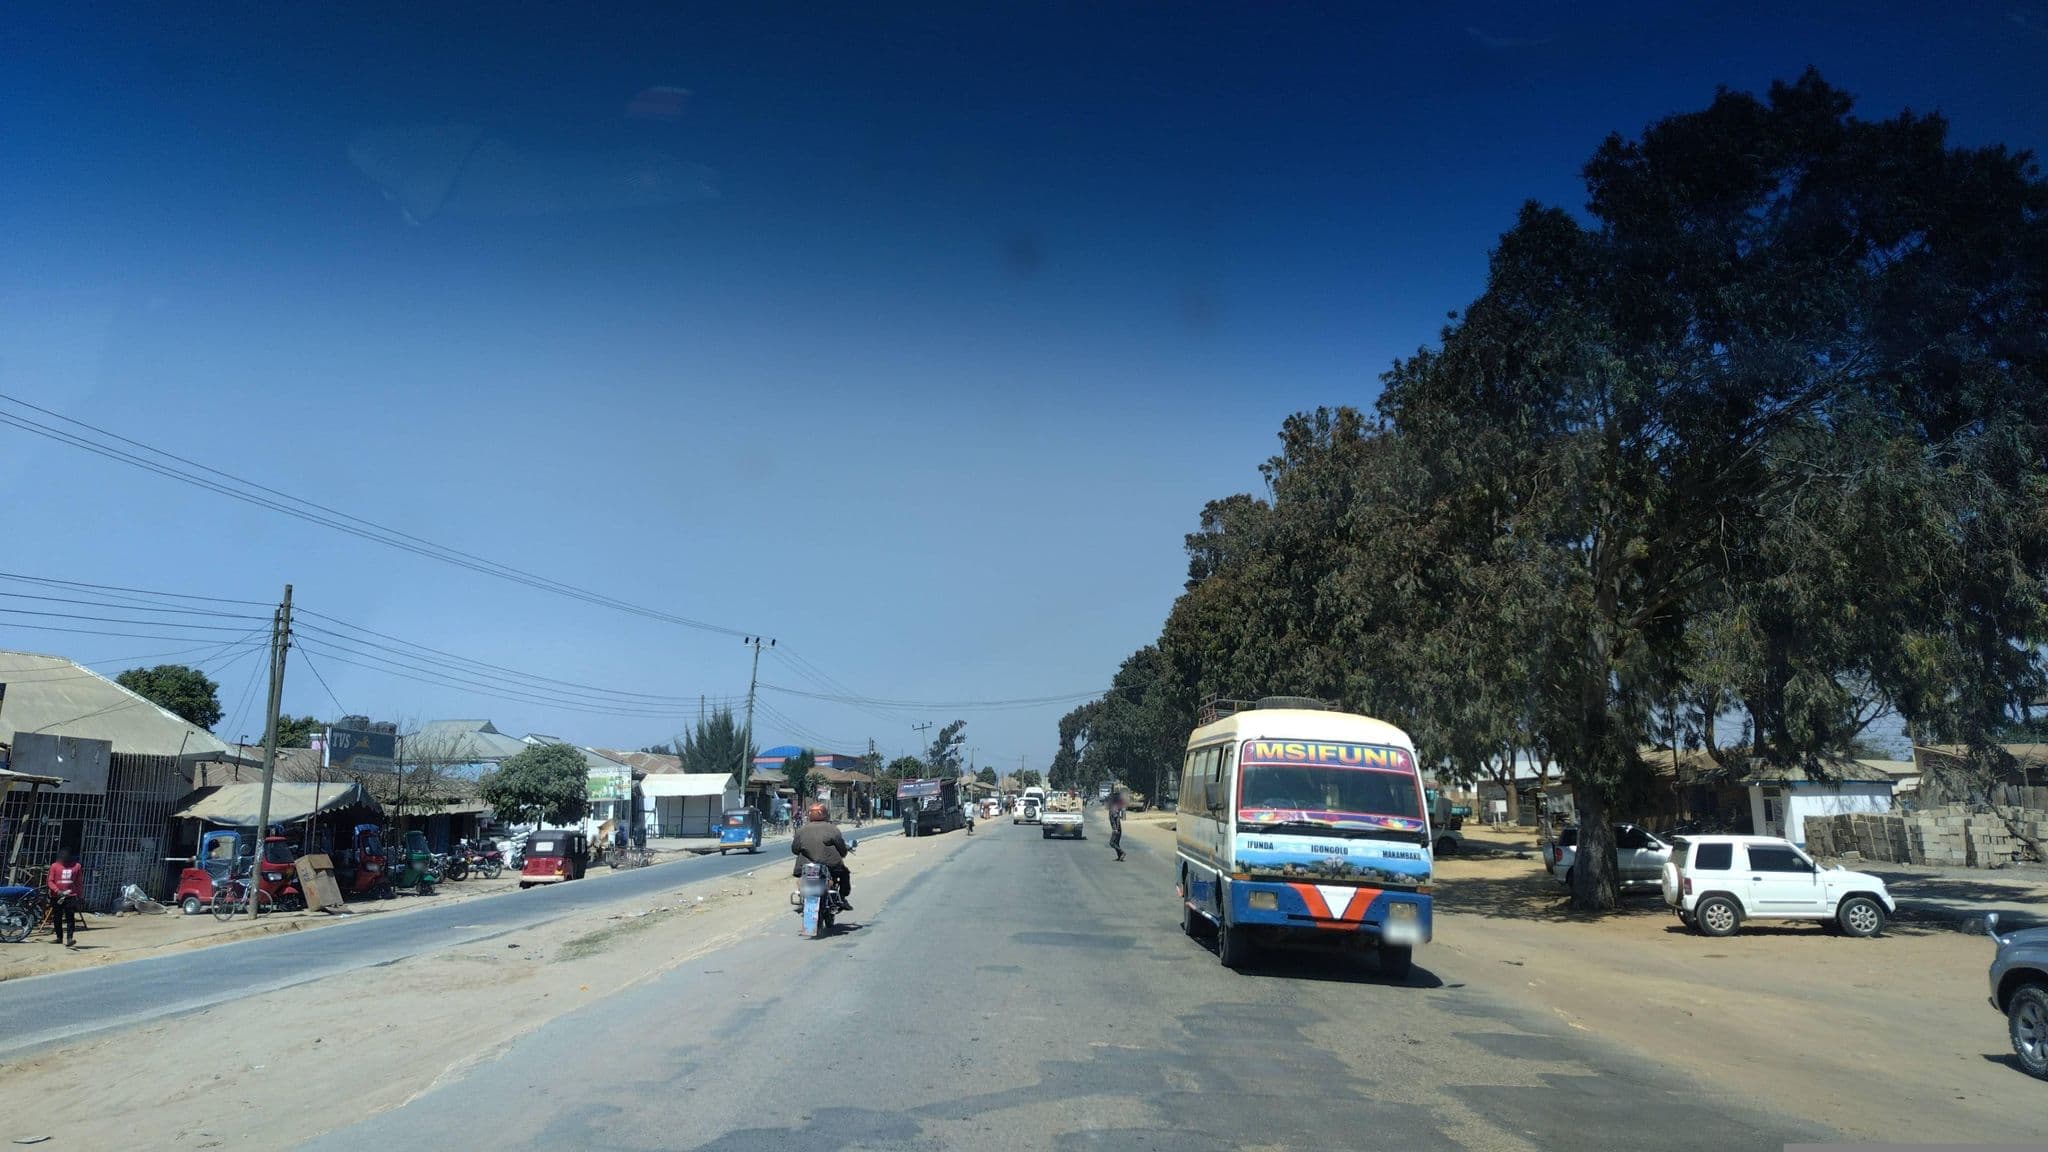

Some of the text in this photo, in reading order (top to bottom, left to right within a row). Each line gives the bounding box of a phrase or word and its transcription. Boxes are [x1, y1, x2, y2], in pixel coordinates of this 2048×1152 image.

[332, 732, 351, 748] TVS
[1255, 743, 1399, 768] MSIFUNI
[1247, 840, 1274, 850] IFUNDA
